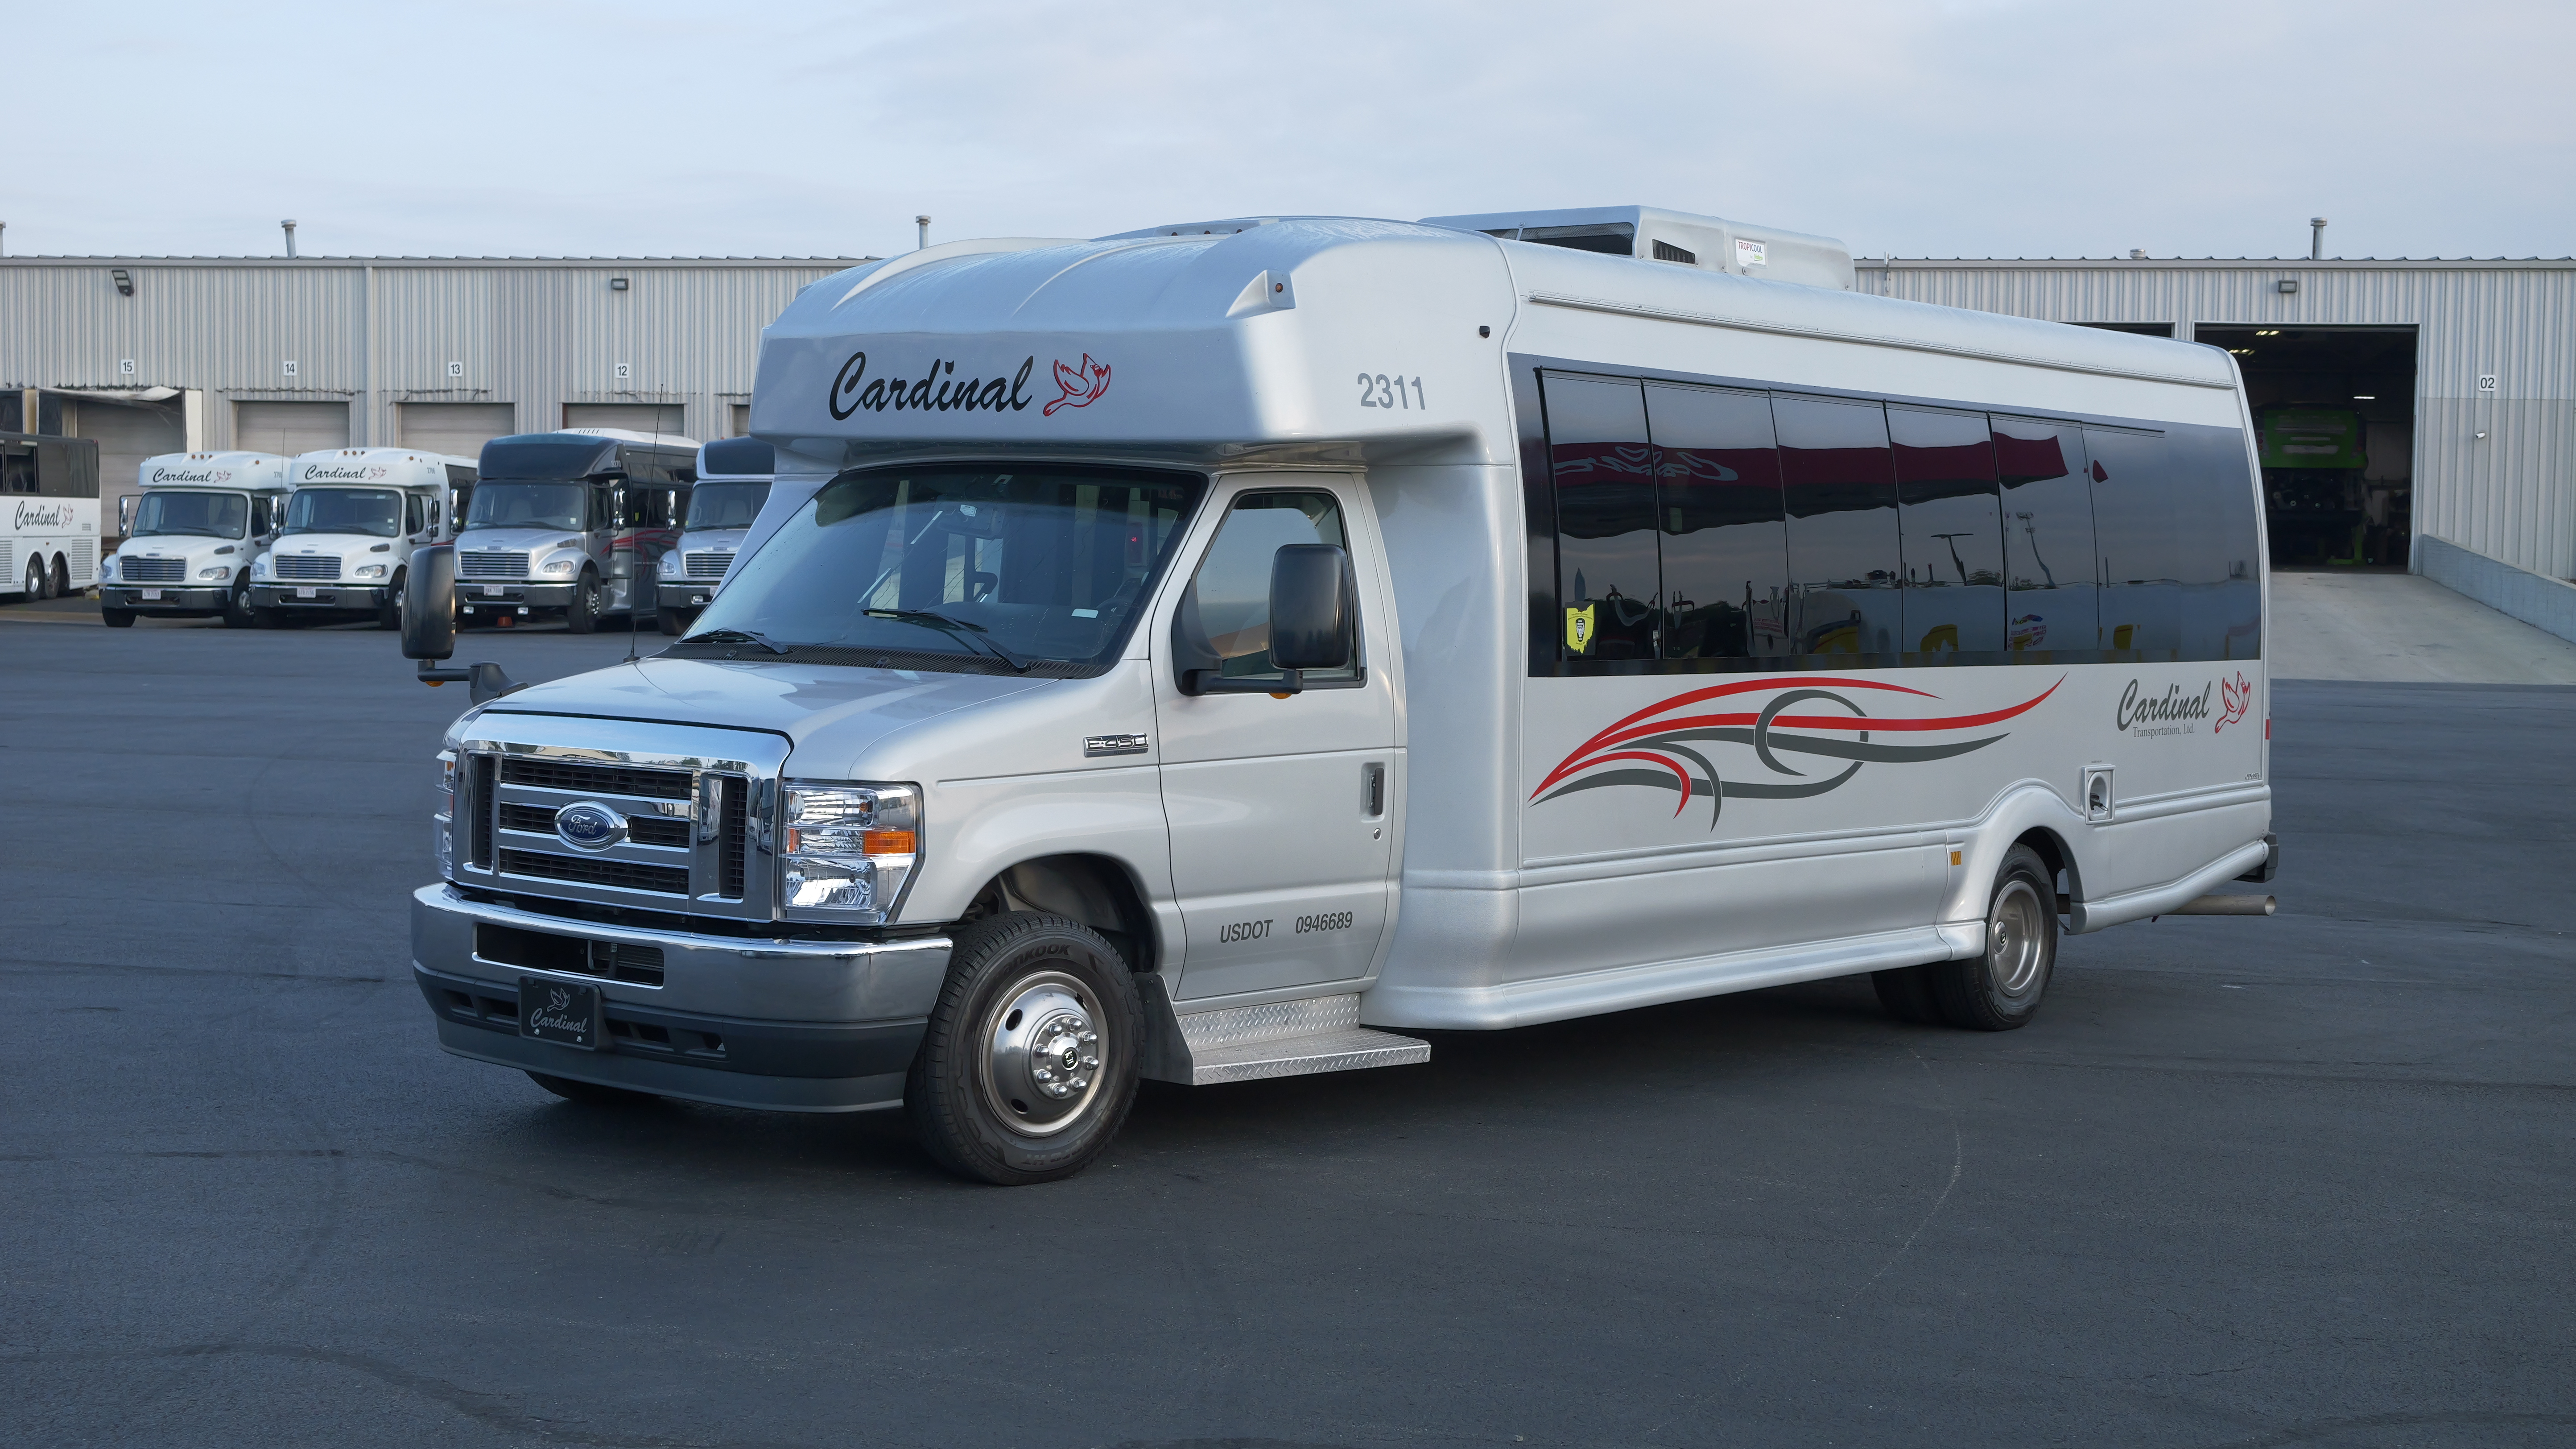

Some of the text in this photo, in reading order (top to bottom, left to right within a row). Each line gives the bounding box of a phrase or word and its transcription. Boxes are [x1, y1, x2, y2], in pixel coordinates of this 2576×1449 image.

[1738, 241, 1763, 253] TROPICOOL
[123, 362, 132, 372] 15
[285, 363, 295, 373] 14
[450, 364, 460, 374] 13
[617, 365, 627, 376] 12
[830, 352, 1033, 421] Cardinal
[2481, 377, 2494, 389] 02
[1358, 373, 1426, 410] 2311
[153, 468, 212, 483] Cardinal
[305, 465, 366, 480] Cardinal
[15, 500, 60, 530] Cardinal
[2117, 679, 2211, 731] Cardinal
[2132, 723, 2195, 739] Transportation, Ltd.
[568, 815, 597, 835] Ford
[1221, 911, 1353, 943] USDOT 0946689
[530, 1007, 587, 1033] Cardinal
